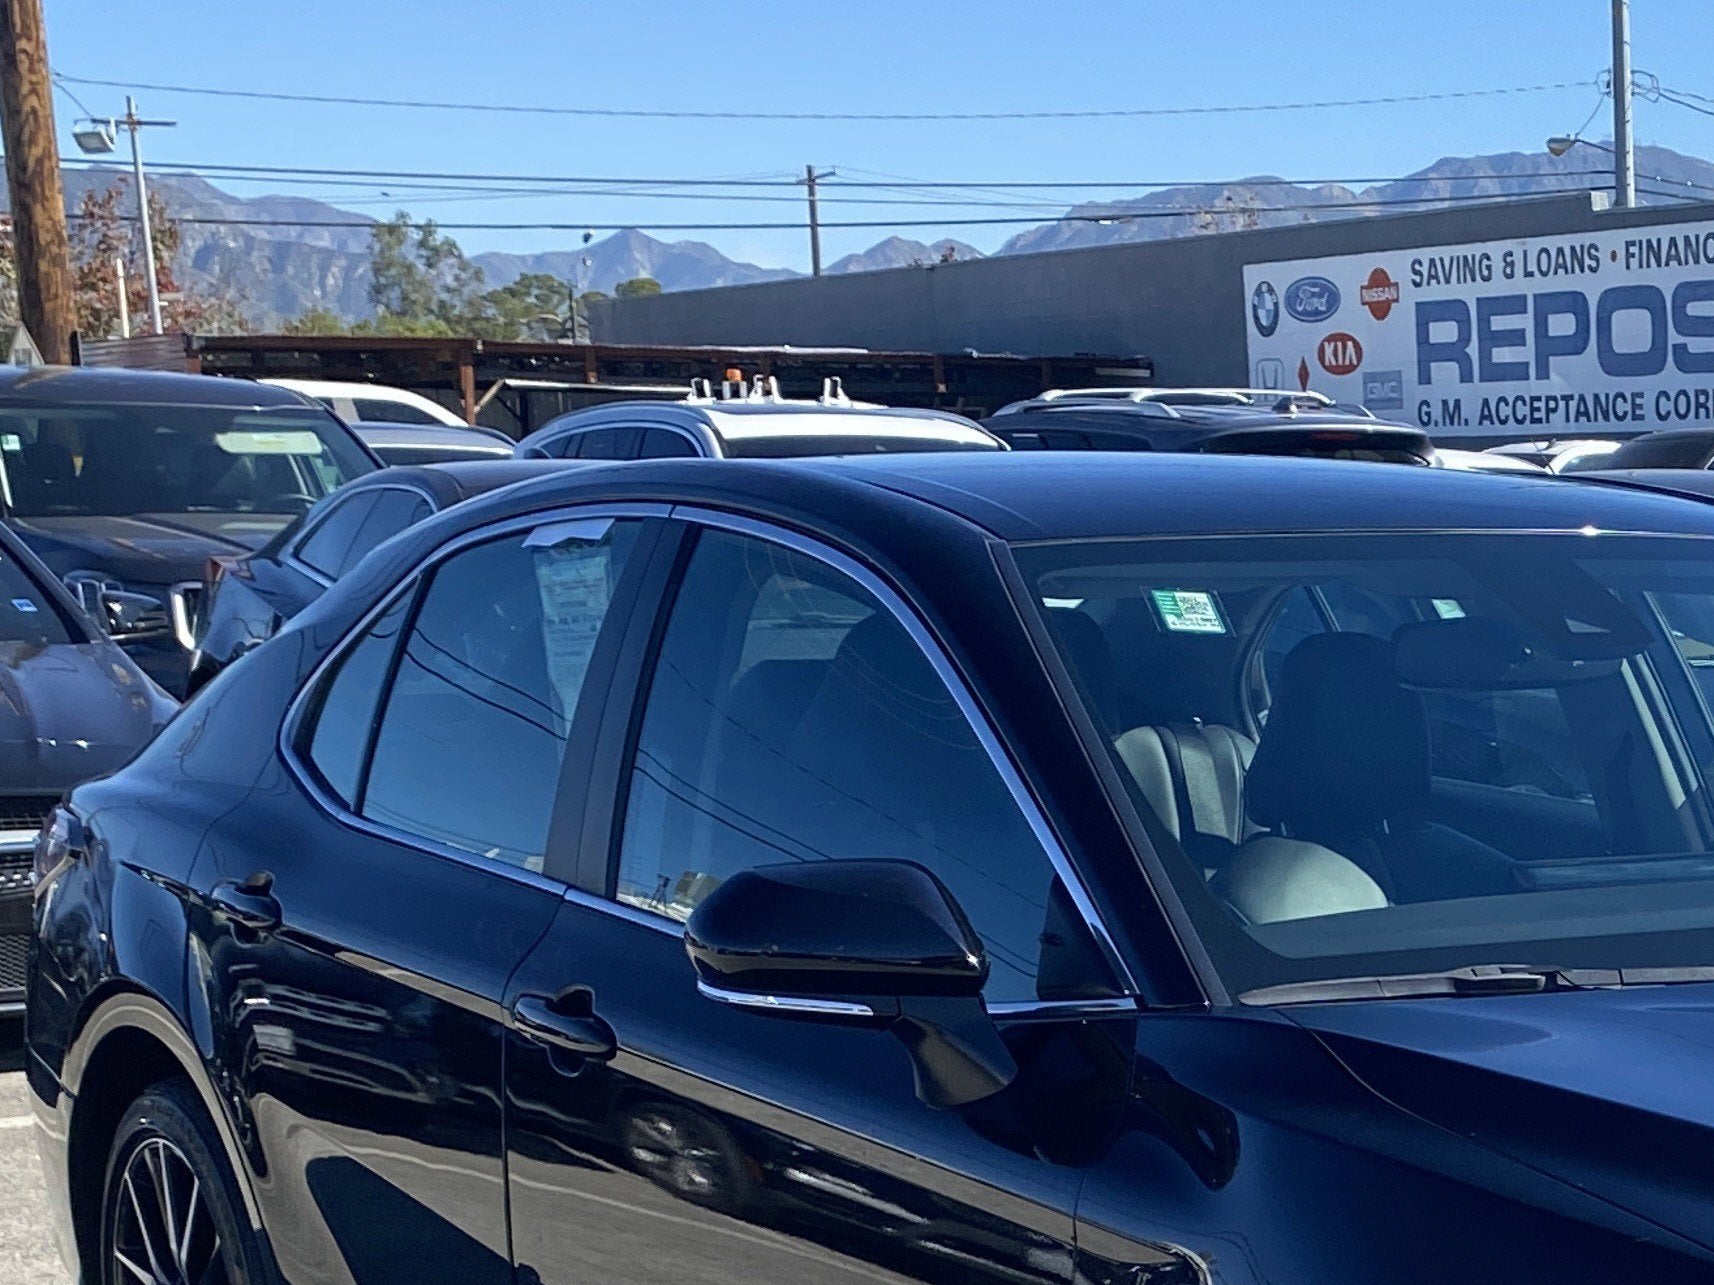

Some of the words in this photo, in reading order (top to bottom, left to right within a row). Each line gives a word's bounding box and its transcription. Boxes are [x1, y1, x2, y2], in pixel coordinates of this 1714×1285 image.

[1410, 256, 1492, 288] SAVING
[1503, 251, 1515, 276] &
[1523, 242, 1600, 275] LOANS
[1296, 286, 1328, 311] Ford
[1323, 340, 1357, 366] KIA
[1417, 395, 1469, 428] G.M.
[1477, 384, 1644, 426] ACCEPTANCE
